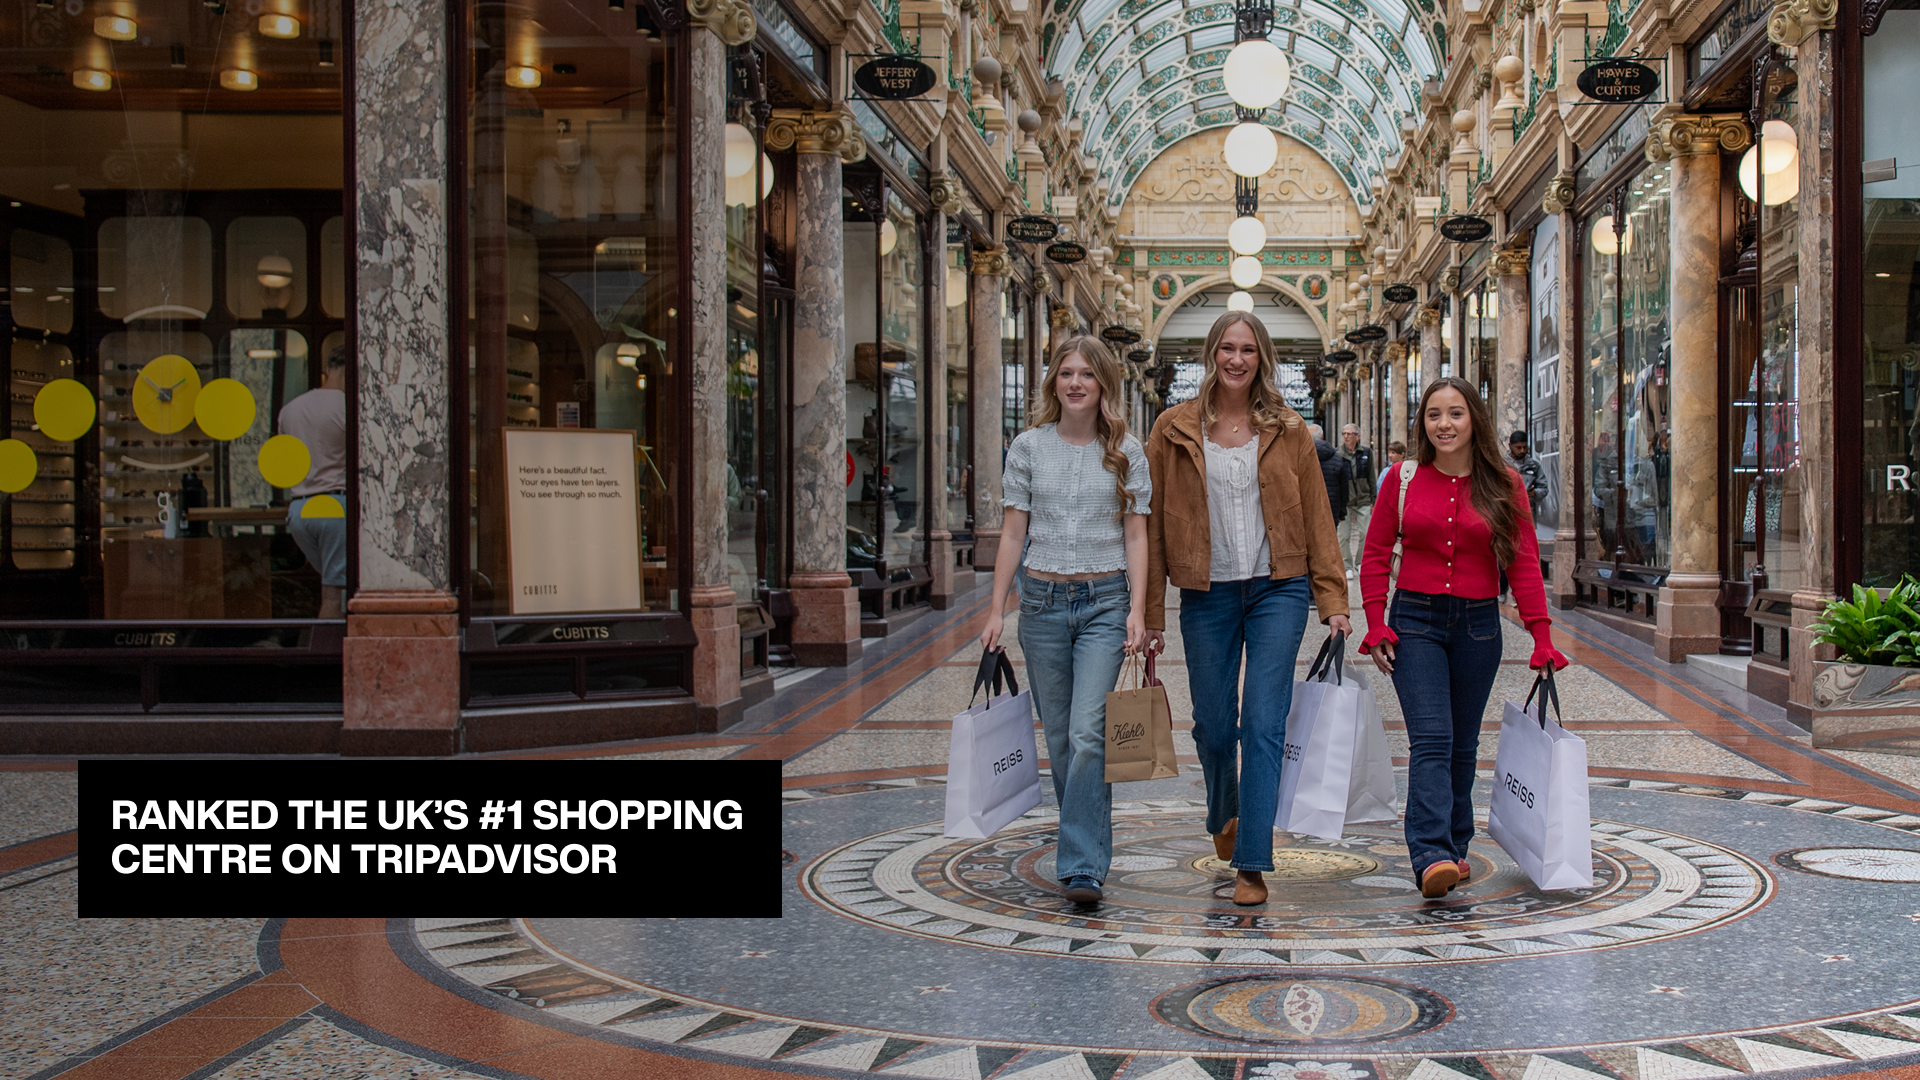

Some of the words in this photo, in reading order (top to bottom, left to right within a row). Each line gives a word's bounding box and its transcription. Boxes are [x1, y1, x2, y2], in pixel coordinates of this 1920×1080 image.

[874, 67, 919, 77] JEFFERY
[1597, 67, 1640, 78] HAWES
[880, 78, 912, 89] WEST
[1614, 77, 1621, 86] &
[1595, 85, 1640, 96] CURTIS
[519, 466, 545, 474] Here's
[553, 466, 588, 474] beautiful
[590, 466, 607, 474] fact.
[520, 478, 538, 486] Your
[540, 480, 559, 488] eyes
[561, 478, 579, 486] have
[596, 478, 621, 488] layers.
[520, 490, 536, 498] You
[554, 490, 585, 499] through
[598, 490, 622, 498] much.
[523, 585, 558, 596] CUBITTS
[552, 626, 609, 640] CUBITTS
[114, 632, 176, 646] CUBITTS
[1110, 722, 1146, 742] Kiehl's
[1285, 743, 1301, 762] REISS
[993, 749, 1024, 776] REISS
[1504, 772, 1535, 809] REISS
